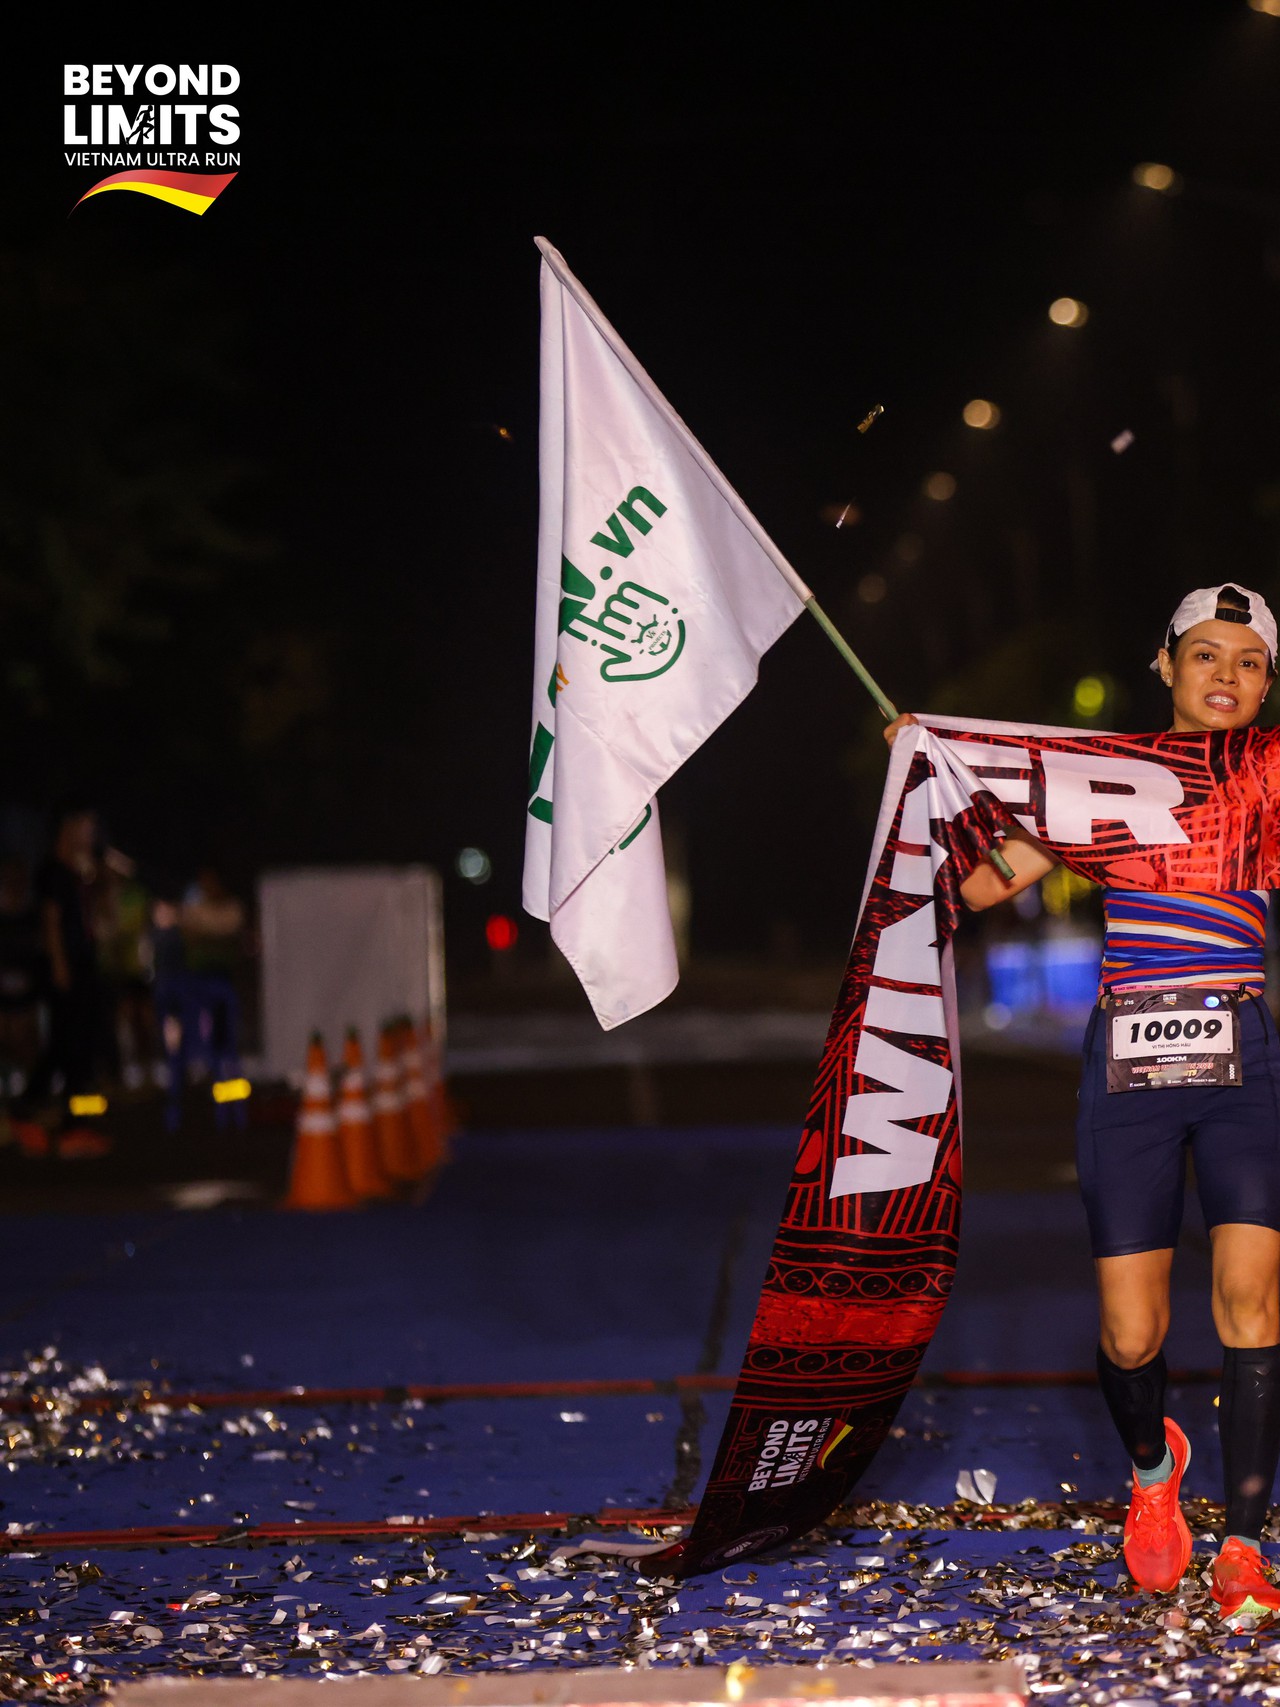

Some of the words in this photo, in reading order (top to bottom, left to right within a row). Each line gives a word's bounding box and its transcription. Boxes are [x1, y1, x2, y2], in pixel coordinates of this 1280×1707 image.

[1131, 1019, 1223, 1043] 10009
[1156, 1055, 1188, 1063] 100KM
[819, 1417, 832, 1432] RUN
[770, 1419, 819, 1488] LIMITS
[813, 1431, 826, 1455] ULTRA
[748, 1420, 790, 1492] BEYOND
